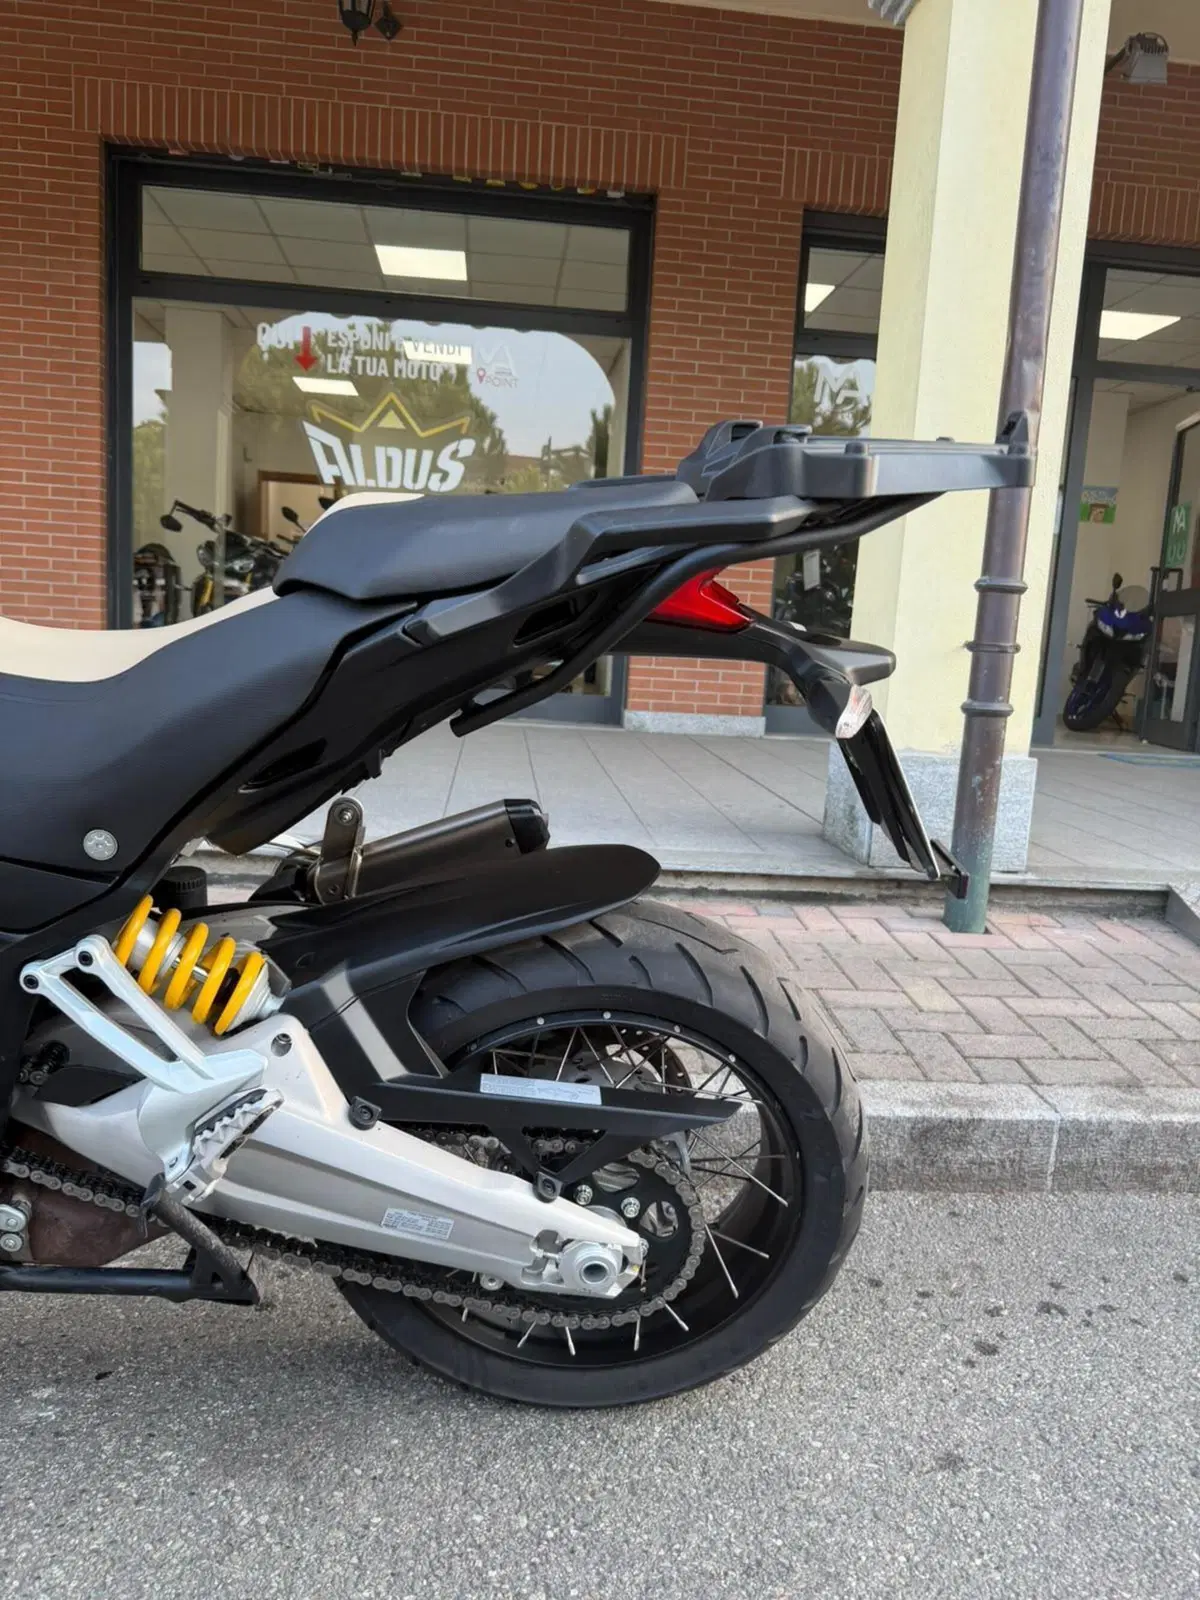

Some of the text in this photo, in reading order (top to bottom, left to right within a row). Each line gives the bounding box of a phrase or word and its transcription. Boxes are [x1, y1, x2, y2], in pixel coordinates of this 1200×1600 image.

[328, 329, 391, 351] ESPONI
[412, 340, 463, 357] VENDI
[327, 355, 350, 375] LA
[354, 356, 389, 377] TUA
[302, 420, 477, 492] ALDUS
